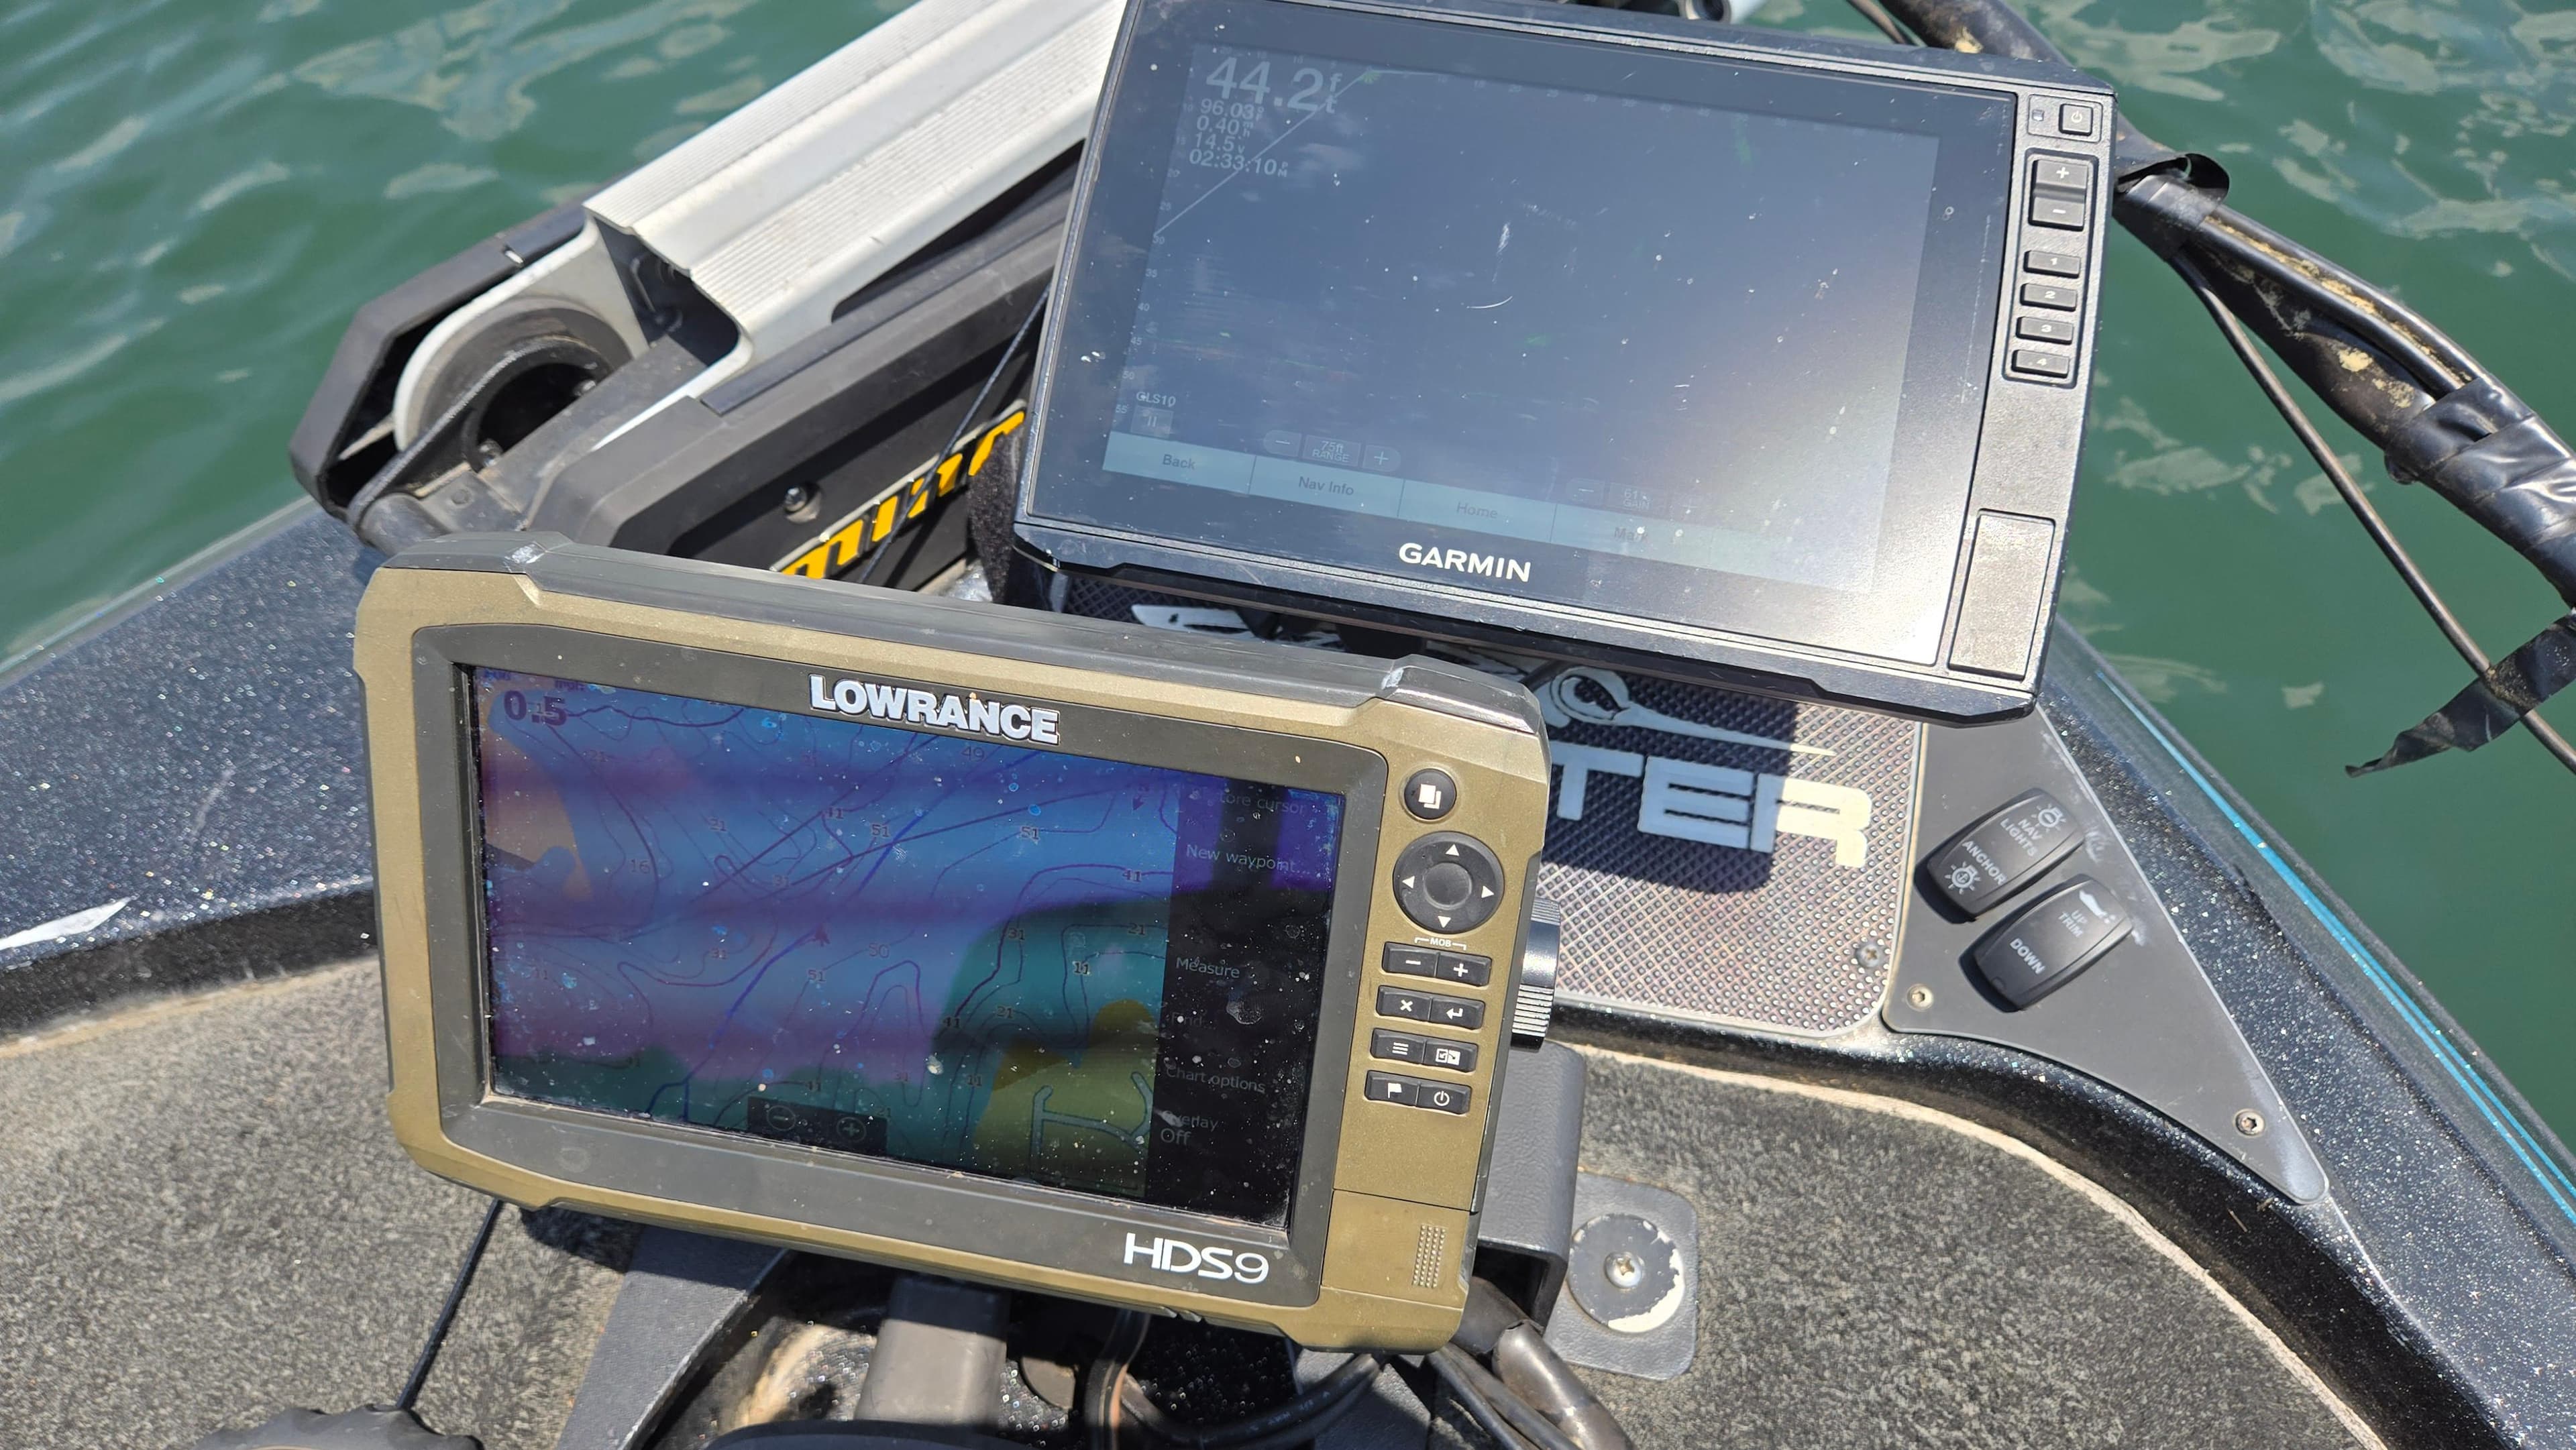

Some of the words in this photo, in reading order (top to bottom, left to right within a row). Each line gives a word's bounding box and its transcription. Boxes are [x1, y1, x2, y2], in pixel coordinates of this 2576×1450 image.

[1205, 55, 1324, 111] 44.2
[1200, 98, 1254, 120] 96.03
[1196, 115, 1240, 136] 0.40
[1195, 134, 1234, 153] 14.5
[1188, 148, 1277, 176] 02:33:10
[2049, 256, 2059, 266] 1
[2044, 290, 2056, 299] 2
[2040, 324, 2052, 333] 3
[2036, 357, 2047, 366] 4
[1136, 391, 1176, 407] GLS10
[1163, 453, 1195, 471] Back
[1311, 449, 1350, 463] RANGE
[1298, 476, 1326, 491] Nav
[1329, 479, 1354, 496] Info
[1455, 501, 1498, 520] Home
[1623, 498, 1650, 510] GAIN
[1399, 542, 1532, 583] GARMIN
[503, 689, 568, 727] 0.5
[808, 673, 1061, 746] LOWRANCE
[961, 746, 985, 761] 49
[1020, 826, 1039, 840] 51
[1999, 818, 2039, 857] LIGHTS
[2018, 818, 2043, 840] NAV
[1186, 844, 1220, 861] New
[630, 858, 650, 874] 16
[1961, 840, 2008, 886] ANCHOR
[1122, 869, 1141, 883] 41
[1128, 923, 1146, 936] 21
[2058, 911, 2084, 938] TRIM
[869, 942, 890, 958] 50
[1429, 937, 1452, 948] MOB
[2009, 938, 2046, 974] DOWN
[808, 968, 826, 982] 51
[1176, 956, 1240, 979] Measure
[996, 1006, 1014, 1018] 21
[1165, 1066, 1206, 1083] Chart
[1210, 1074, 1266, 1091] options
[1161, 1127, 1192, 1145] Off
[1122, 1232, 1270, 1285] HDS9
